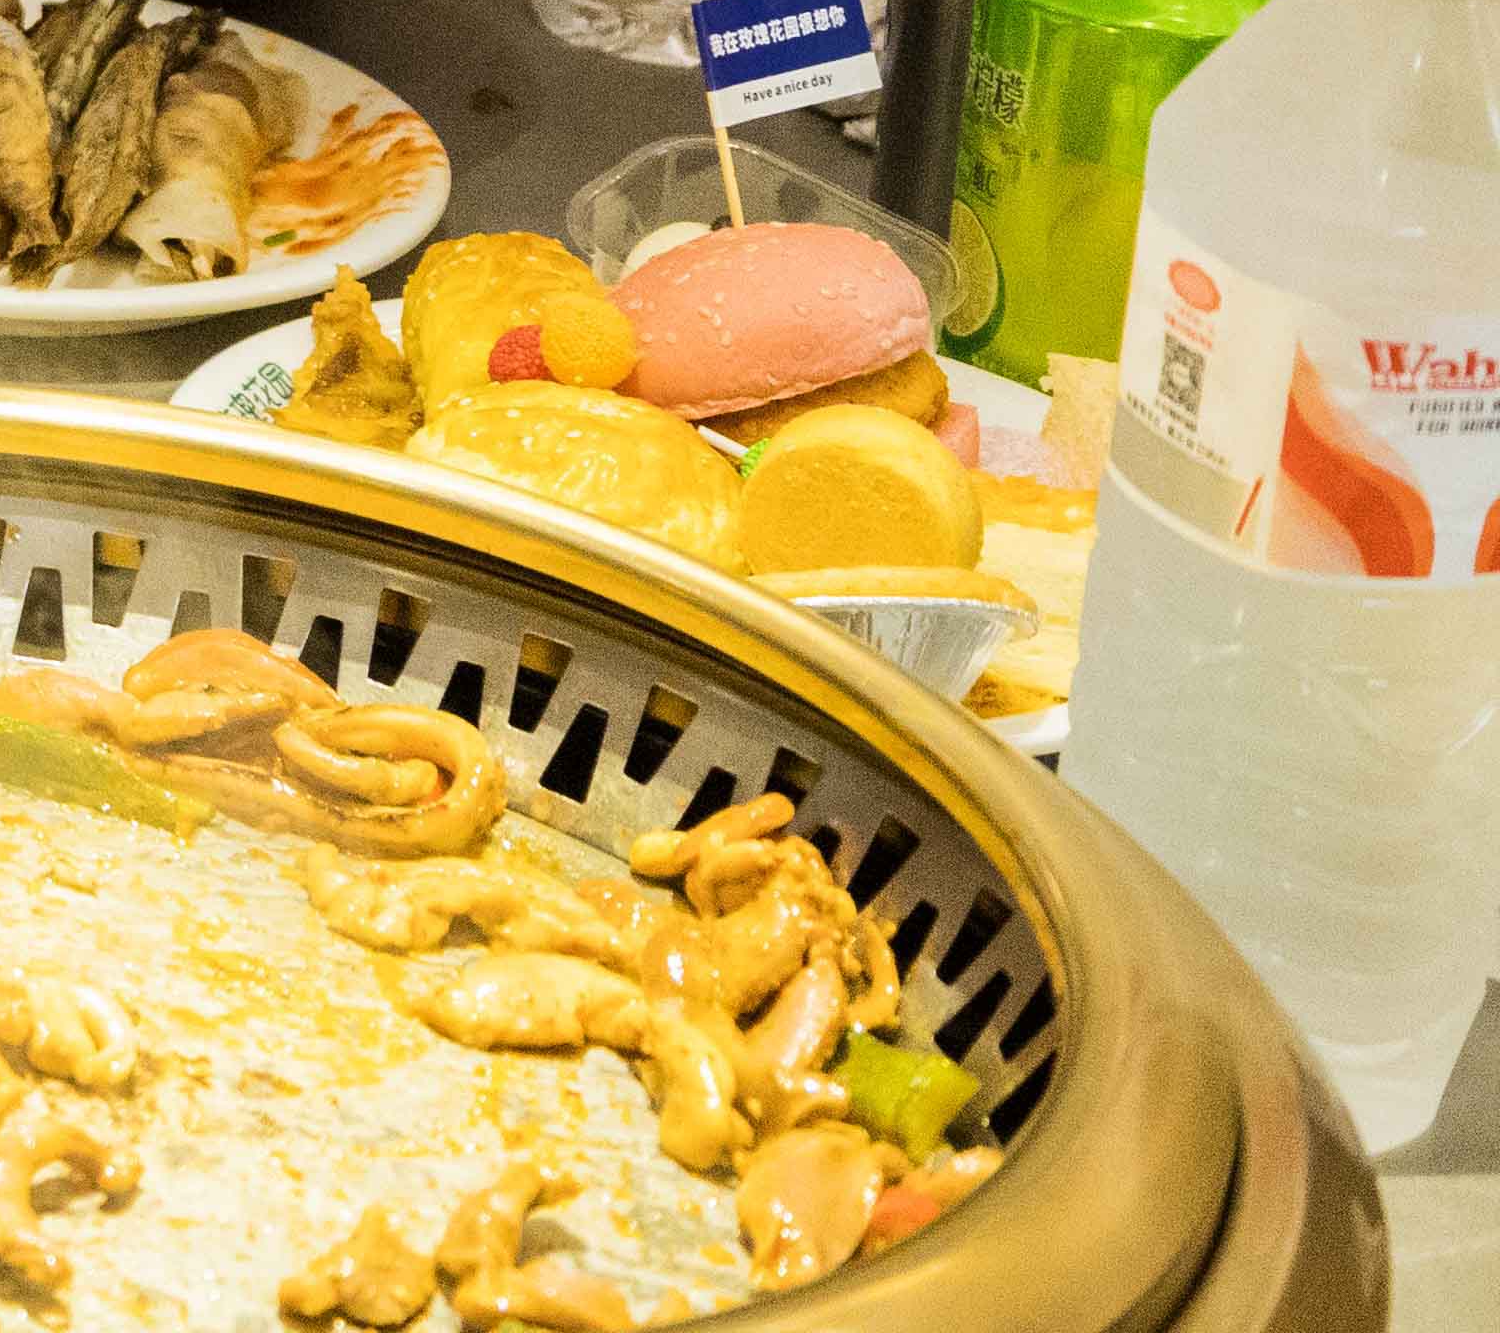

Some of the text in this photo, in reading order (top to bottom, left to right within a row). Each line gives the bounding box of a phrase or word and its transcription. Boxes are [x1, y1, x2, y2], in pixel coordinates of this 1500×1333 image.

[743, 73, 833, 104] Have a nice day
